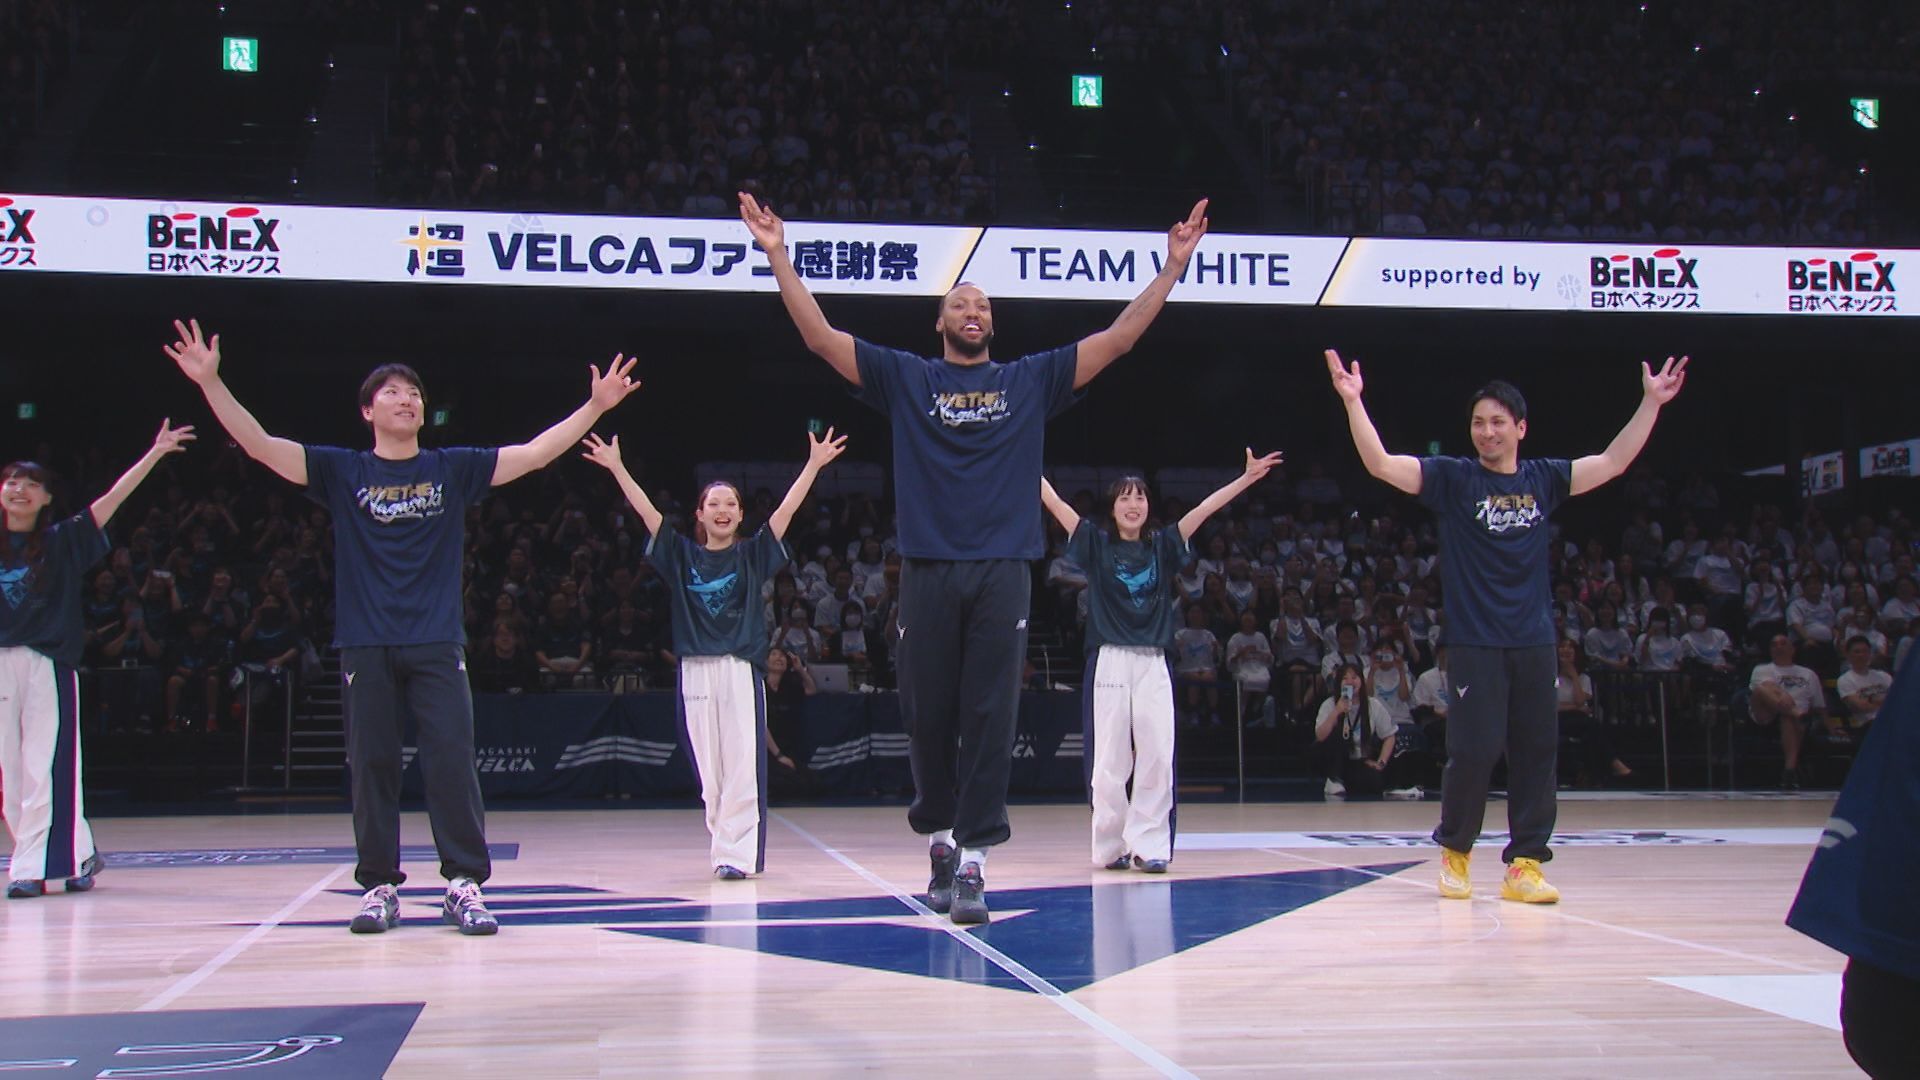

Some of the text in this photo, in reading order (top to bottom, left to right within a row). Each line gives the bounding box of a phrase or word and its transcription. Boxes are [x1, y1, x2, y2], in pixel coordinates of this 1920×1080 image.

[148, 214, 281, 252] BENEX
[148, 253, 281, 274] 日本ベネックス
[1010, 246, 1135, 283] TEAM
[1590, 256, 1699, 289] BENEX
[1788, 260, 1896, 292] BENEX
[1381, 265, 1541, 292] supported by
[1591, 291, 1701, 308] 日本ベネックス
[1788, 294, 1897, 312] 日本ベネックス
[475, 746, 537, 756] AGASAKI
